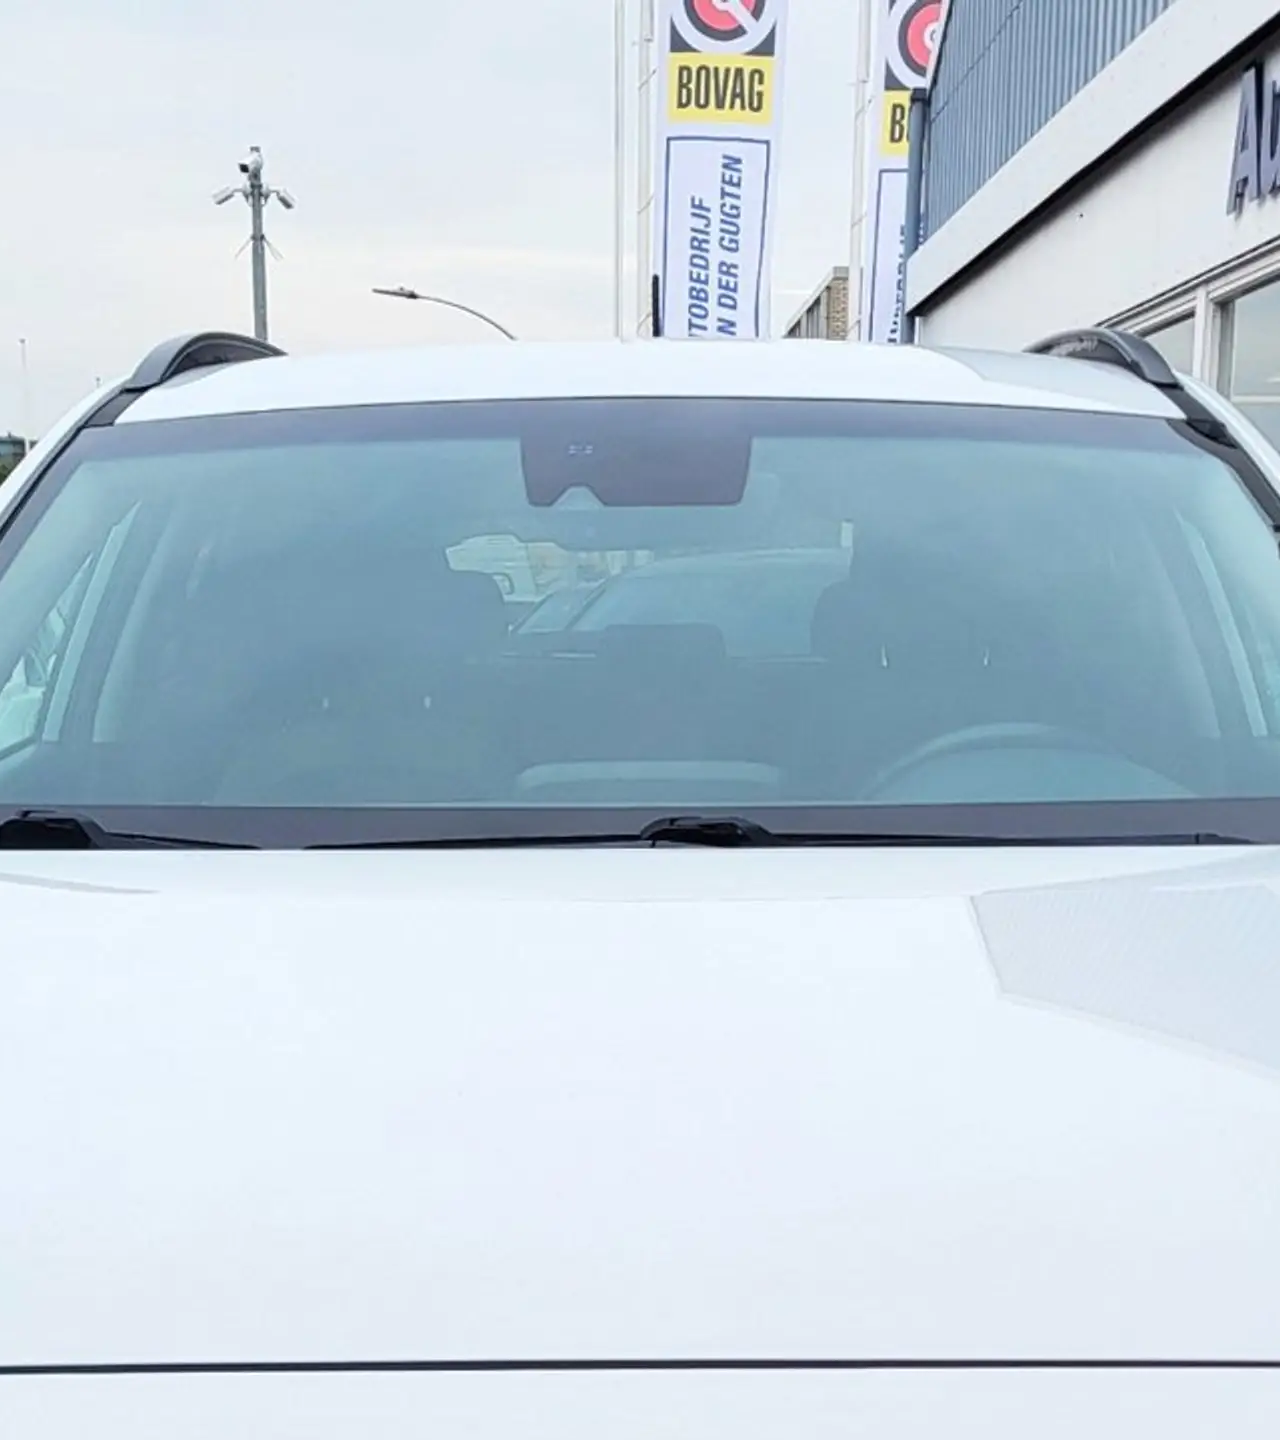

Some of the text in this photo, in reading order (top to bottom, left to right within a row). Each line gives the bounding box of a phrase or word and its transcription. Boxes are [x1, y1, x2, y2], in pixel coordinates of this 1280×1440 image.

[676, 65, 765, 112] BOVAG
[719, 154, 743, 254] GUGTEN
[688, 196, 711, 337] TOBEDRIJF
[717, 260, 739, 311] DER
